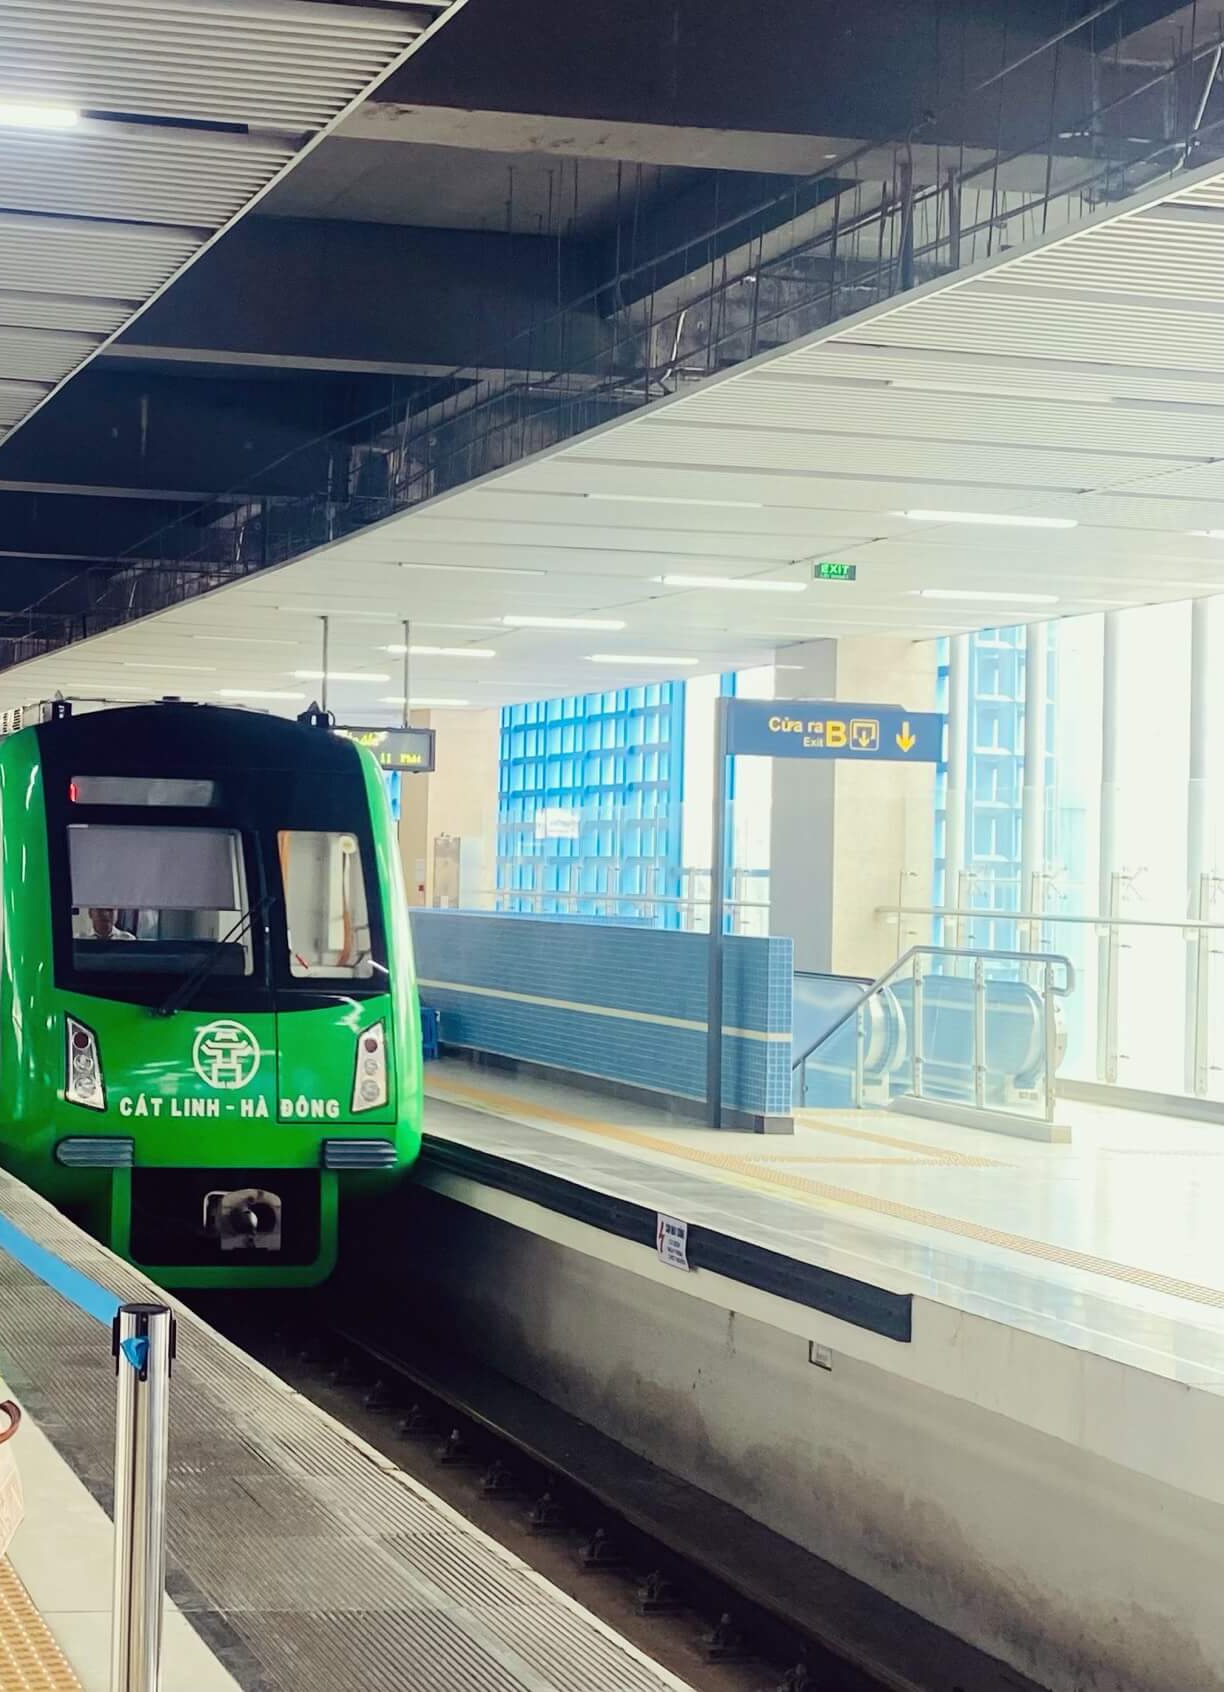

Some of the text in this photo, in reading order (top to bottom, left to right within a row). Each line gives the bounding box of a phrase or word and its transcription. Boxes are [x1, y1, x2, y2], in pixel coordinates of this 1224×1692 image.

[821, 563, 849, 575] EXIT
[768, 716, 848, 748] Cửa ra B
[803, 736, 824, 748] Exit
[119, 1093, 163, 1117] CÁT
[171, 1098, 220, 1117] LINH
[240, 1095, 269, 1118] HÀ
[280, 1095, 340, 1119] ĐÔNG
